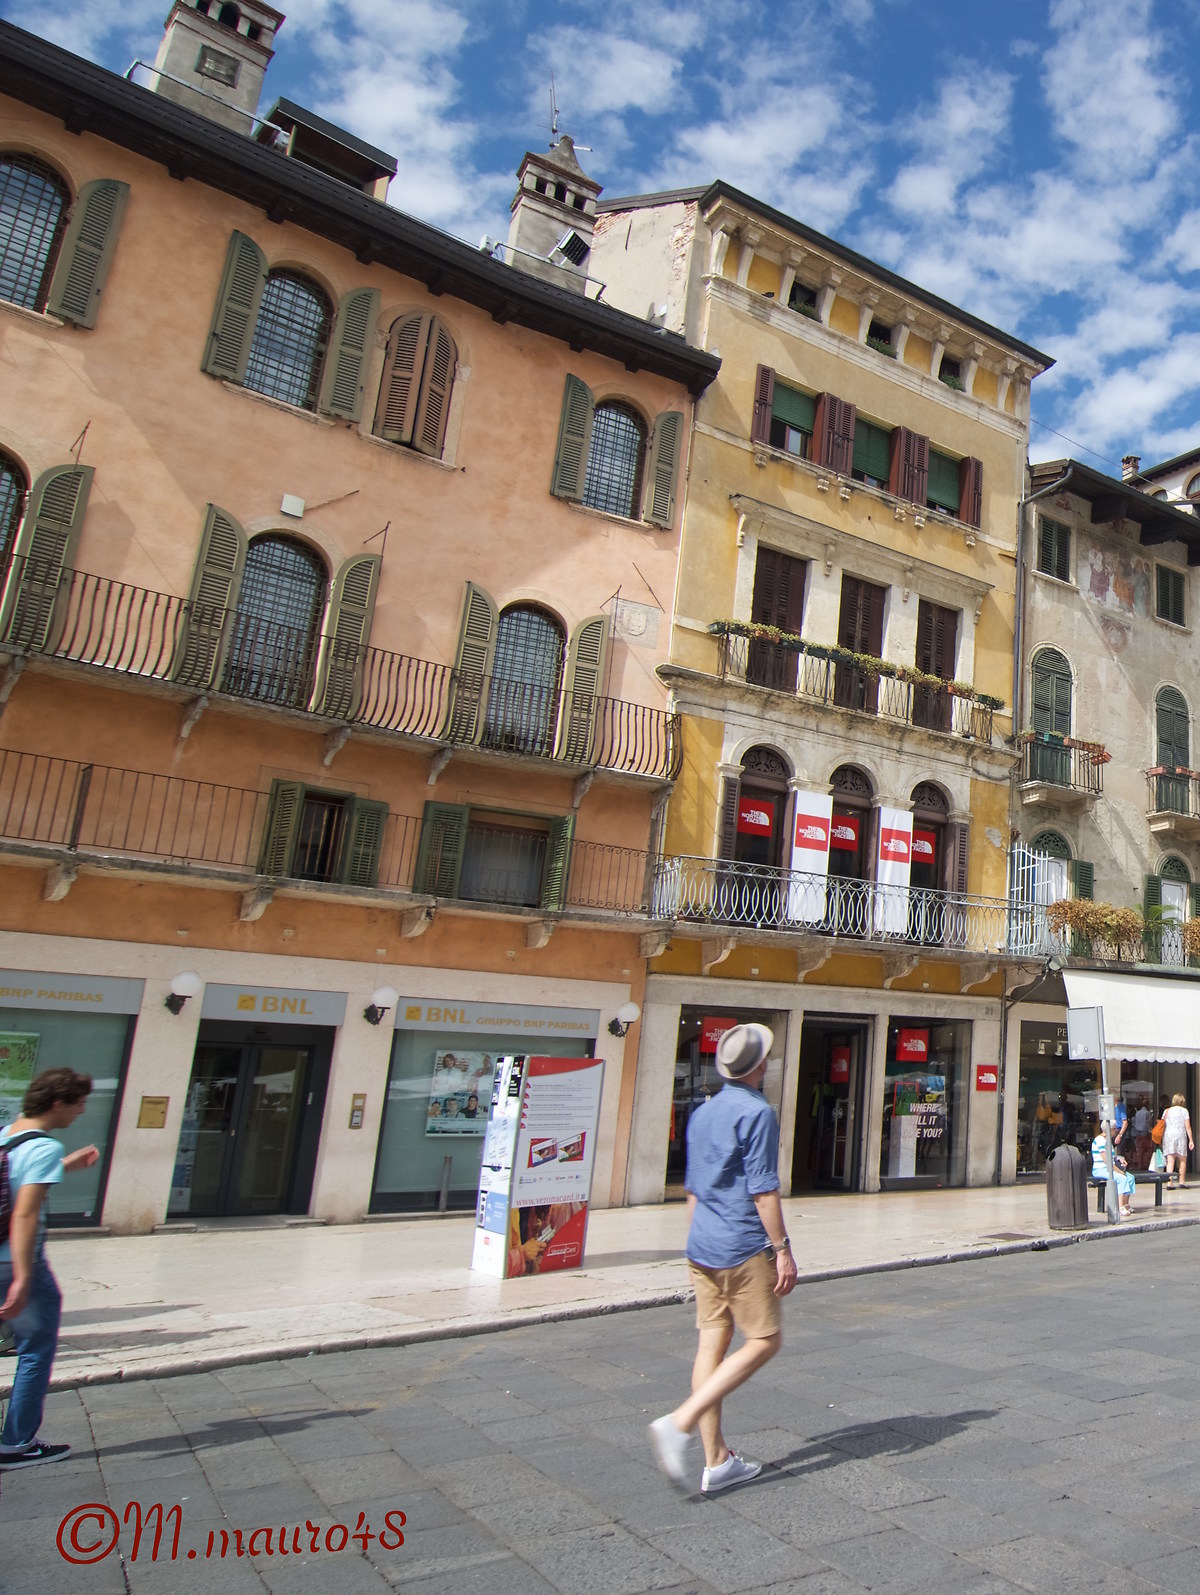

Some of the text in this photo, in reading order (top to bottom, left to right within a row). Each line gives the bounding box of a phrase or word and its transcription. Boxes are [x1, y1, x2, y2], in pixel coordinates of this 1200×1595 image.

[0, 987, 104, 1002] BNP PARIBAS
[261, 996, 314, 1015] BNL
[426, 1007, 591, 1031] BNL GRUPPO BNP PARIBAS
[928, 1116, 938, 1125] IT
[922, 1128, 943, 1138] YOU?
[516, 1193, 580, 1206] www.veronacard.it
